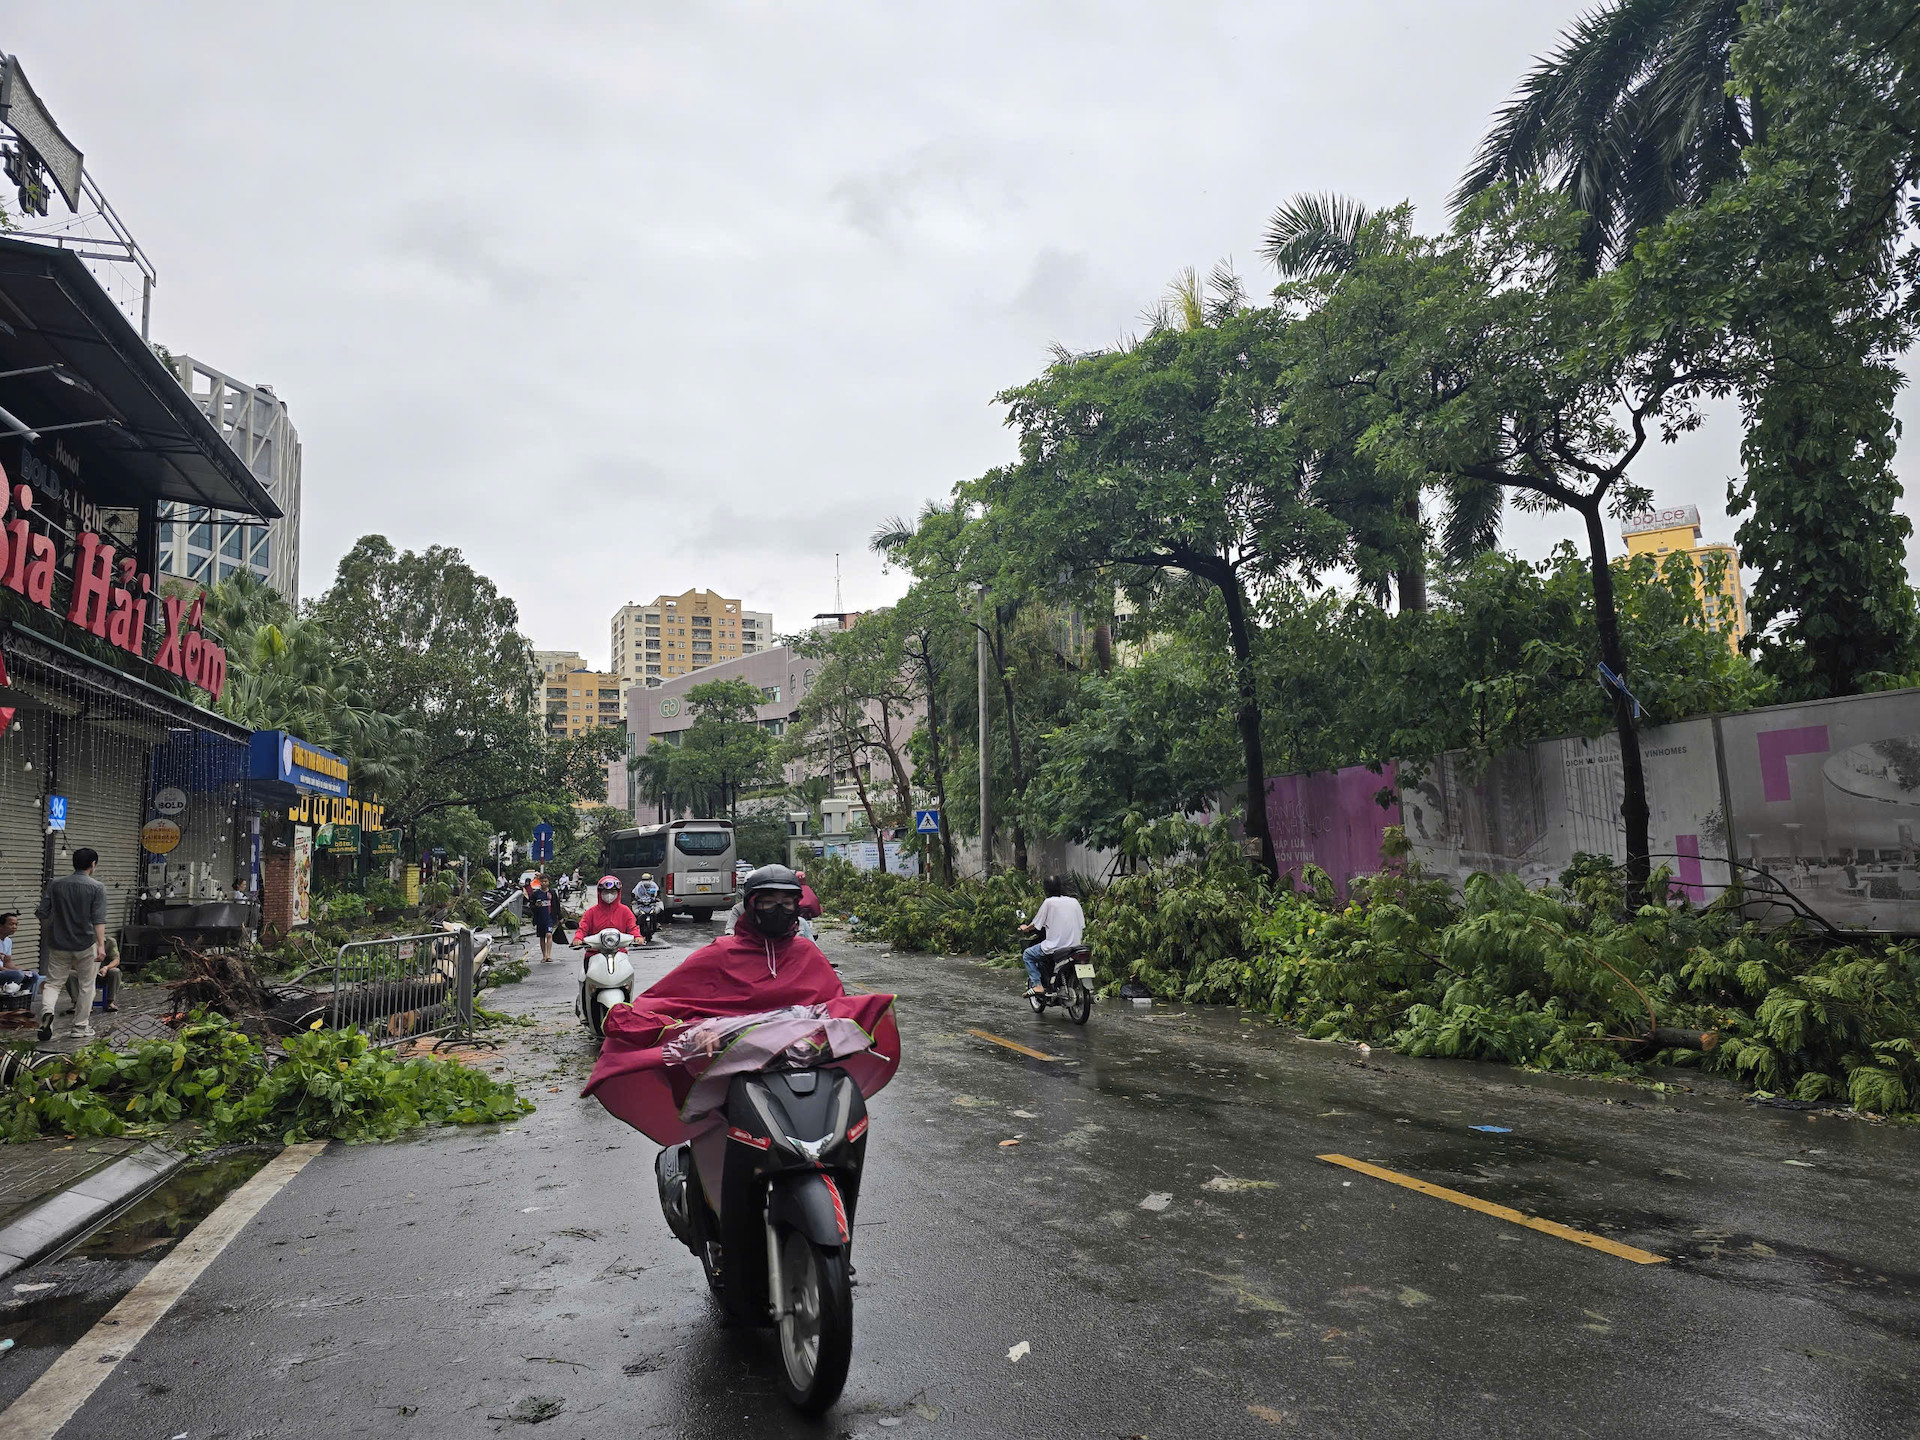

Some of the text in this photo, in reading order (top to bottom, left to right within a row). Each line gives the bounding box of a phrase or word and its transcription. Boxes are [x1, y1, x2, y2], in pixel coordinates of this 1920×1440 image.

[55, 437, 80, 477] Hanoi
[20, 447, 60, 500] BOLD
[62, 488, 71, 509] &
[67, 532, 151, 657] Hải
[1565, 758, 1584, 769] DỊCH
[1644, 746, 1688, 759] VINHOMES
[52, 797, 65, 819] 86
[158, 801, 184, 809] BOLD
[1294, 849, 1315, 862] VINH
